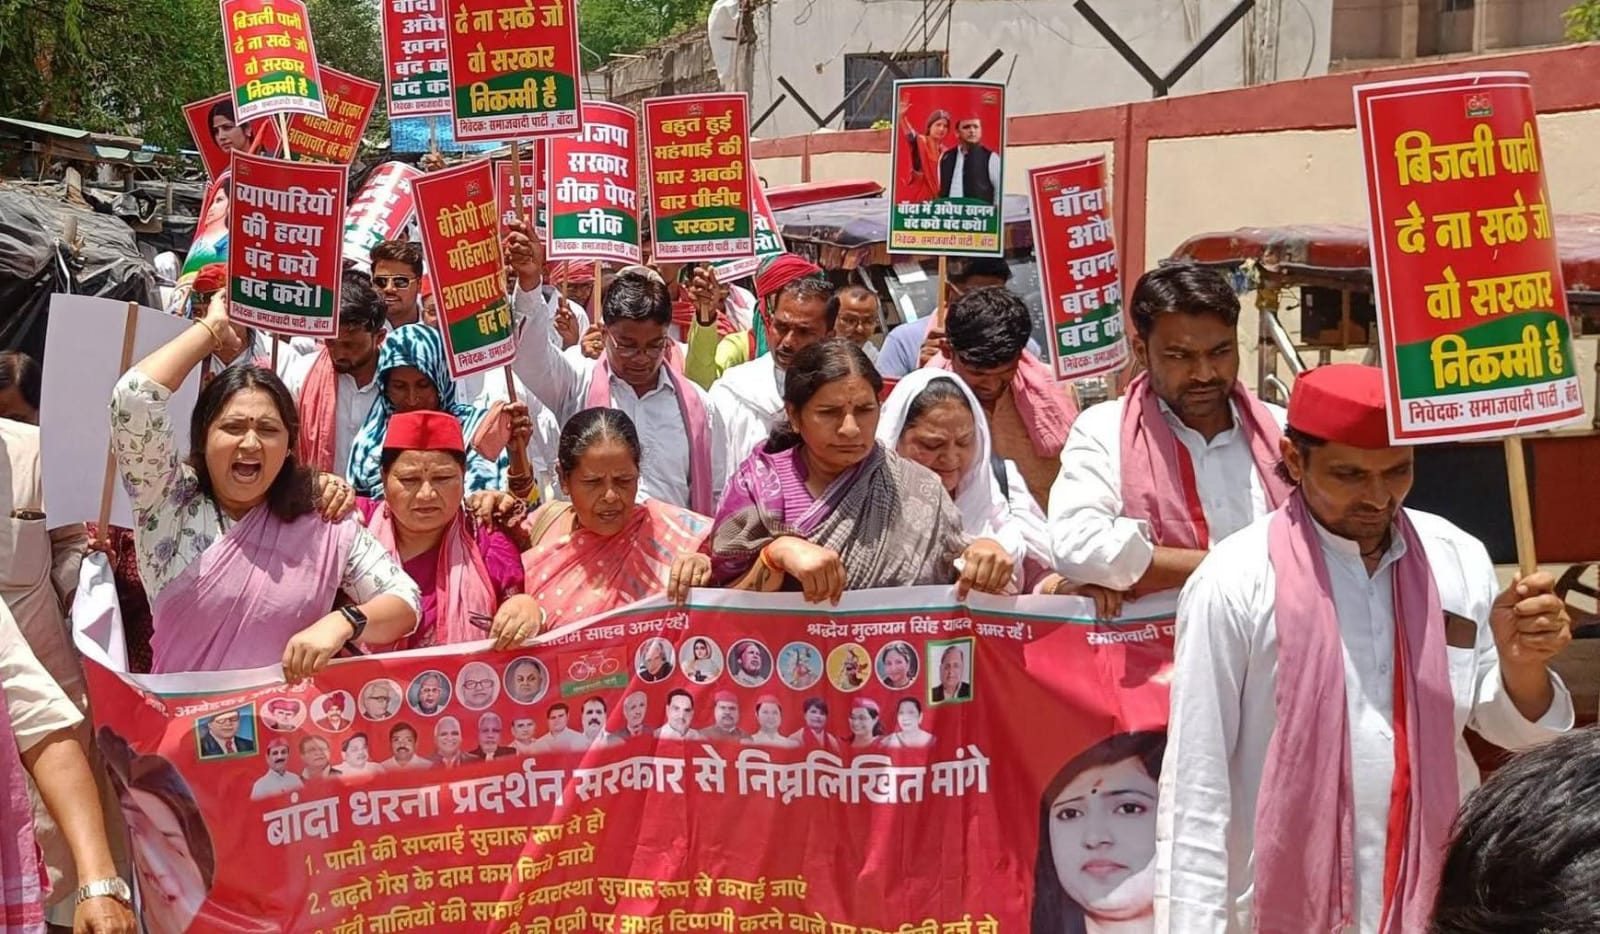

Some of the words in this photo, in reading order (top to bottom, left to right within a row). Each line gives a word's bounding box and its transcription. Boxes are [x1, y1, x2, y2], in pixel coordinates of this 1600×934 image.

[233, 6, 274, 31] बिजली
[276, 12, 302, 30] पानी
[454, 4, 469, 34] दे
[472, 10, 494, 32] ना
[497, 1, 535, 30] सके
[540, 0, 564, 27] जो
[233, 35, 244, 54] दे
[247, 36, 262, 50] ना
[264, 31, 291, 47] सके
[293, 36, 308, 53] जो
[467, 42, 486, 73] वो
[489, 46, 555, 71] सरकार
[244, 56, 258, 75] वो
[261, 58, 305, 73] सरकार
[394, 56, 424, 75] बंद
[247, 75, 295, 100] निकम्मी
[298, 77, 308, 96] है
[392, 78, 422, 96] बंद
[470, 78, 538, 113] निकम्मी
[542, 76, 557, 108] है
[661, 117, 700, 137] बहुत
[705, 110, 732, 135] हुई
[654, 137, 714, 159] महंगाई
[718, 135, 741, 155] की
[1394, 123, 1496, 186] बिजली
[1499, 121, 1540, 174] पानी
[567, 153, 628, 178] सरकार
[655, 169, 685, 184] मार
[690, 160, 743, 183] अबकी
[236, 182, 337, 216] व्यापारियों
[556, 177, 599, 203] वीक
[604, 178, 636, 210] पेपर
[659, 194, 687, 209] बार
[691, 186, 742, 207] पीडीए
[241, 212, 268, 240] की
[274, 222, 324, 247] हत्या
[436, 201, 480, 238] बीजेपी
[577, 208, 623, 235] लीक
[673, 217, 736, 234] सरकार
[1394, 200, 1426, 254] दे
[1432, 210, 1471, 250] ना
[1477, 189, 1528, 248] सके
[1529, 188, 1551, 239] जो
[244, 242, 274, 271] बंद
[278, 250, 319, 277] करो
[240, 272, 268, 301] बंद
[443, 273, 498, 311] अत्याचार
[1060, 284, 1100, 314] बंद
[1424, 264, 1462, 320] वो
[1467, 270, 1554, 316] सरकार
[477, 305, 498, 335] बंद
[1058, 317, 1099, 347] बंद
[1430, 324, 1543, 390] निकम्मी
[1547, 320, 1564, 376] है
[1469, 388, 1534, 418] समाजवादी
[629, 617, 665, 635] अमर
[807, 620, 848, 638] श्रद्धेय
[851, 621, 907, 642] मुलायम
[910, 616, 939, 634] सिंह
[942, 617, 973, 631] यादव
[976, 623, 1005, 638] अमर
[1086, 624, 1159, 645] समाजवादी
[263, 792, 340, 846] बांदा
[350, 785, 440, 826] धरना
[448, 758, 565, 814] प्रदर्शन
[574, 755, 685, 803] सरकार
[693, 744, 727, 796] से
[931, 744, 990, 797] मांगे
[323, 839, 366, 870] पानी
[370, 835, 398, 861] की
[401, 824, 465, 855] सप्लाई
[468, 826, 529, 856] सुचारू
[531, 825, 564, 845] रूप
[566, 815, 582, 834] से
[585, 808, 606, 834] हो
[328, 876, 373, 911] बढ़ते
[376, 870, 408, 896] गैस
[412, 865, 434, 891] के
[437, 866, 474, 888] दाम
[478, 864, 513, 884] कम
[517, 854, 554, 883] किये
[557, 841, 595, 867] जाये
[368, 901, 435, 934] नालियों
[439, 897, 467, 922] की
[470, 892, 525, 921] सफाई
[527, 878, 594, 905] व्यवस्था
[597, 877, 654, 905] सुचारू
[658, 880, 690, 898] रूप
[694, 872, 713, 897] से
[717, 876, 766, 904] कराई
[770, 874, 807, 899] जाएं
[591, 912, 616, 932] पर
[669, 907, 735, 933] टिप्पणी
[739, 907, 784, 932] करने
[789, 911, 827, 934] वाले
